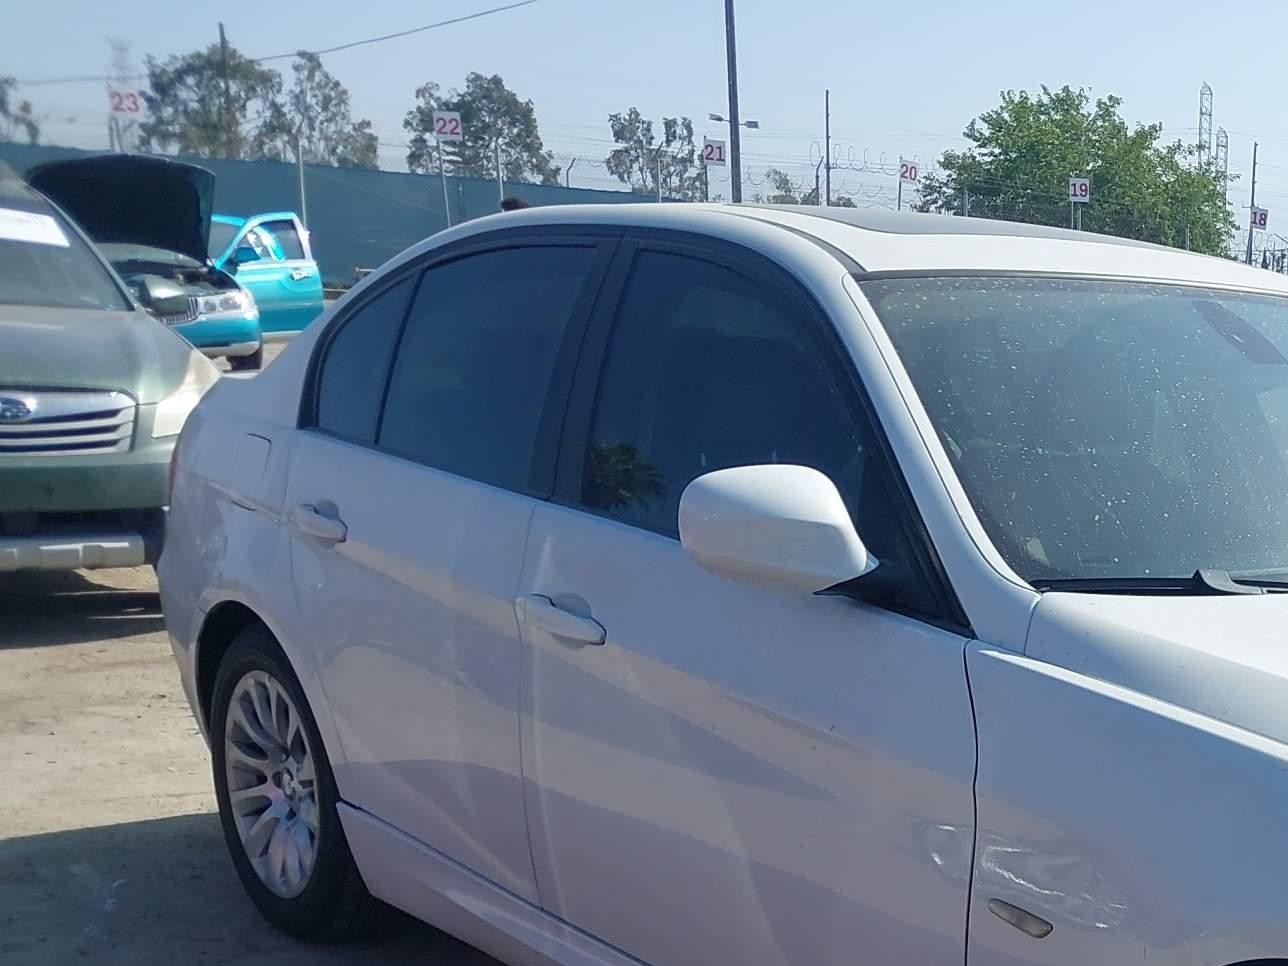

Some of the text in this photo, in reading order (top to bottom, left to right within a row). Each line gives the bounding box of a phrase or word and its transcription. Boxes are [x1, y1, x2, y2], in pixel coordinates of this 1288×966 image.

[110, 91, 140, 113] 23
[436, 117, 461, 135] 22
[705, 144, 726, 161] 21
[900, 164, 917, 181] 20
[1071, 183, 1088, 197] 19
[1251, 212, 1267, 226] 18
